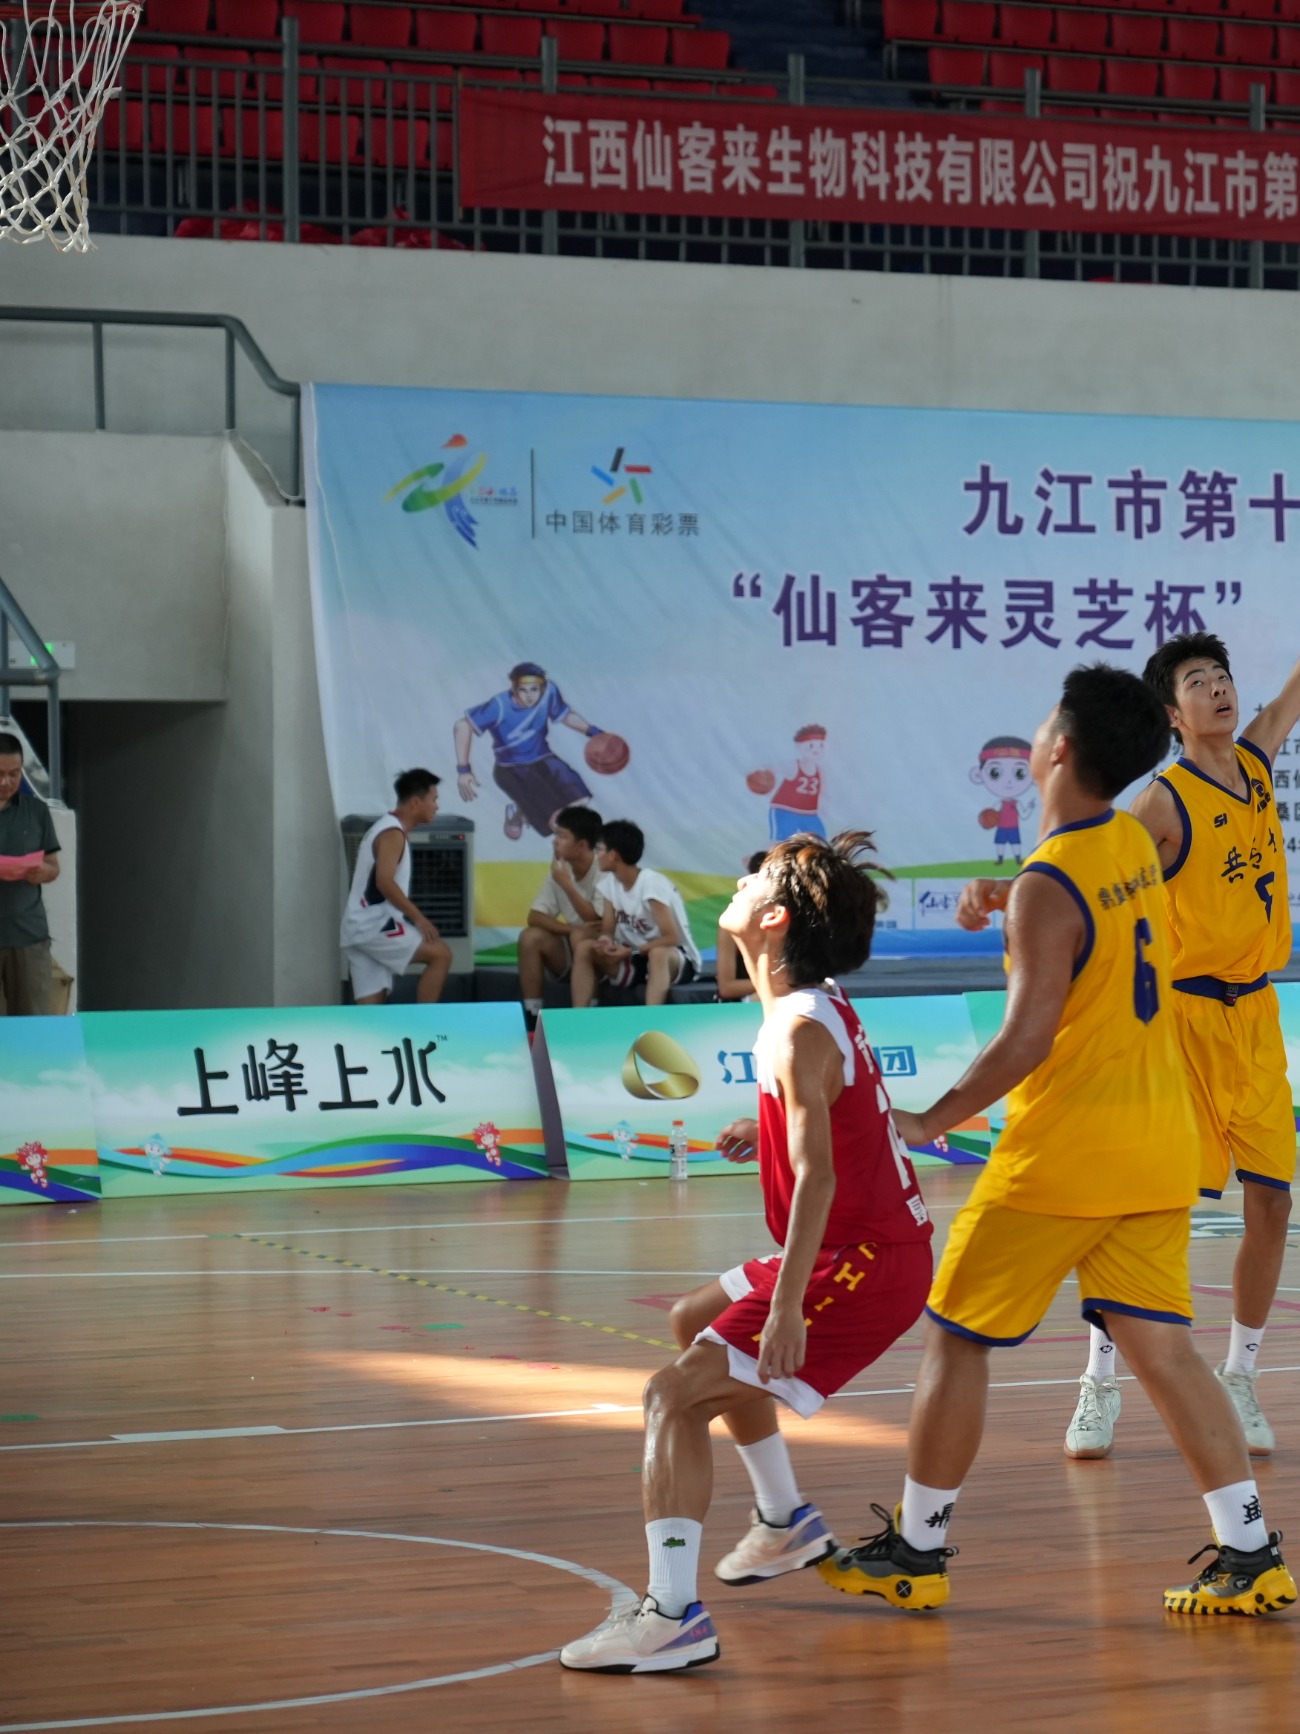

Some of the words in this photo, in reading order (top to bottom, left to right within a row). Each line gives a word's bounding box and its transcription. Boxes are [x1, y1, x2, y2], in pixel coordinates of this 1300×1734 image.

[545, 510, 700, 537] 中国体育彩票
[176, 1037, 446, 1117] 上峰上水
